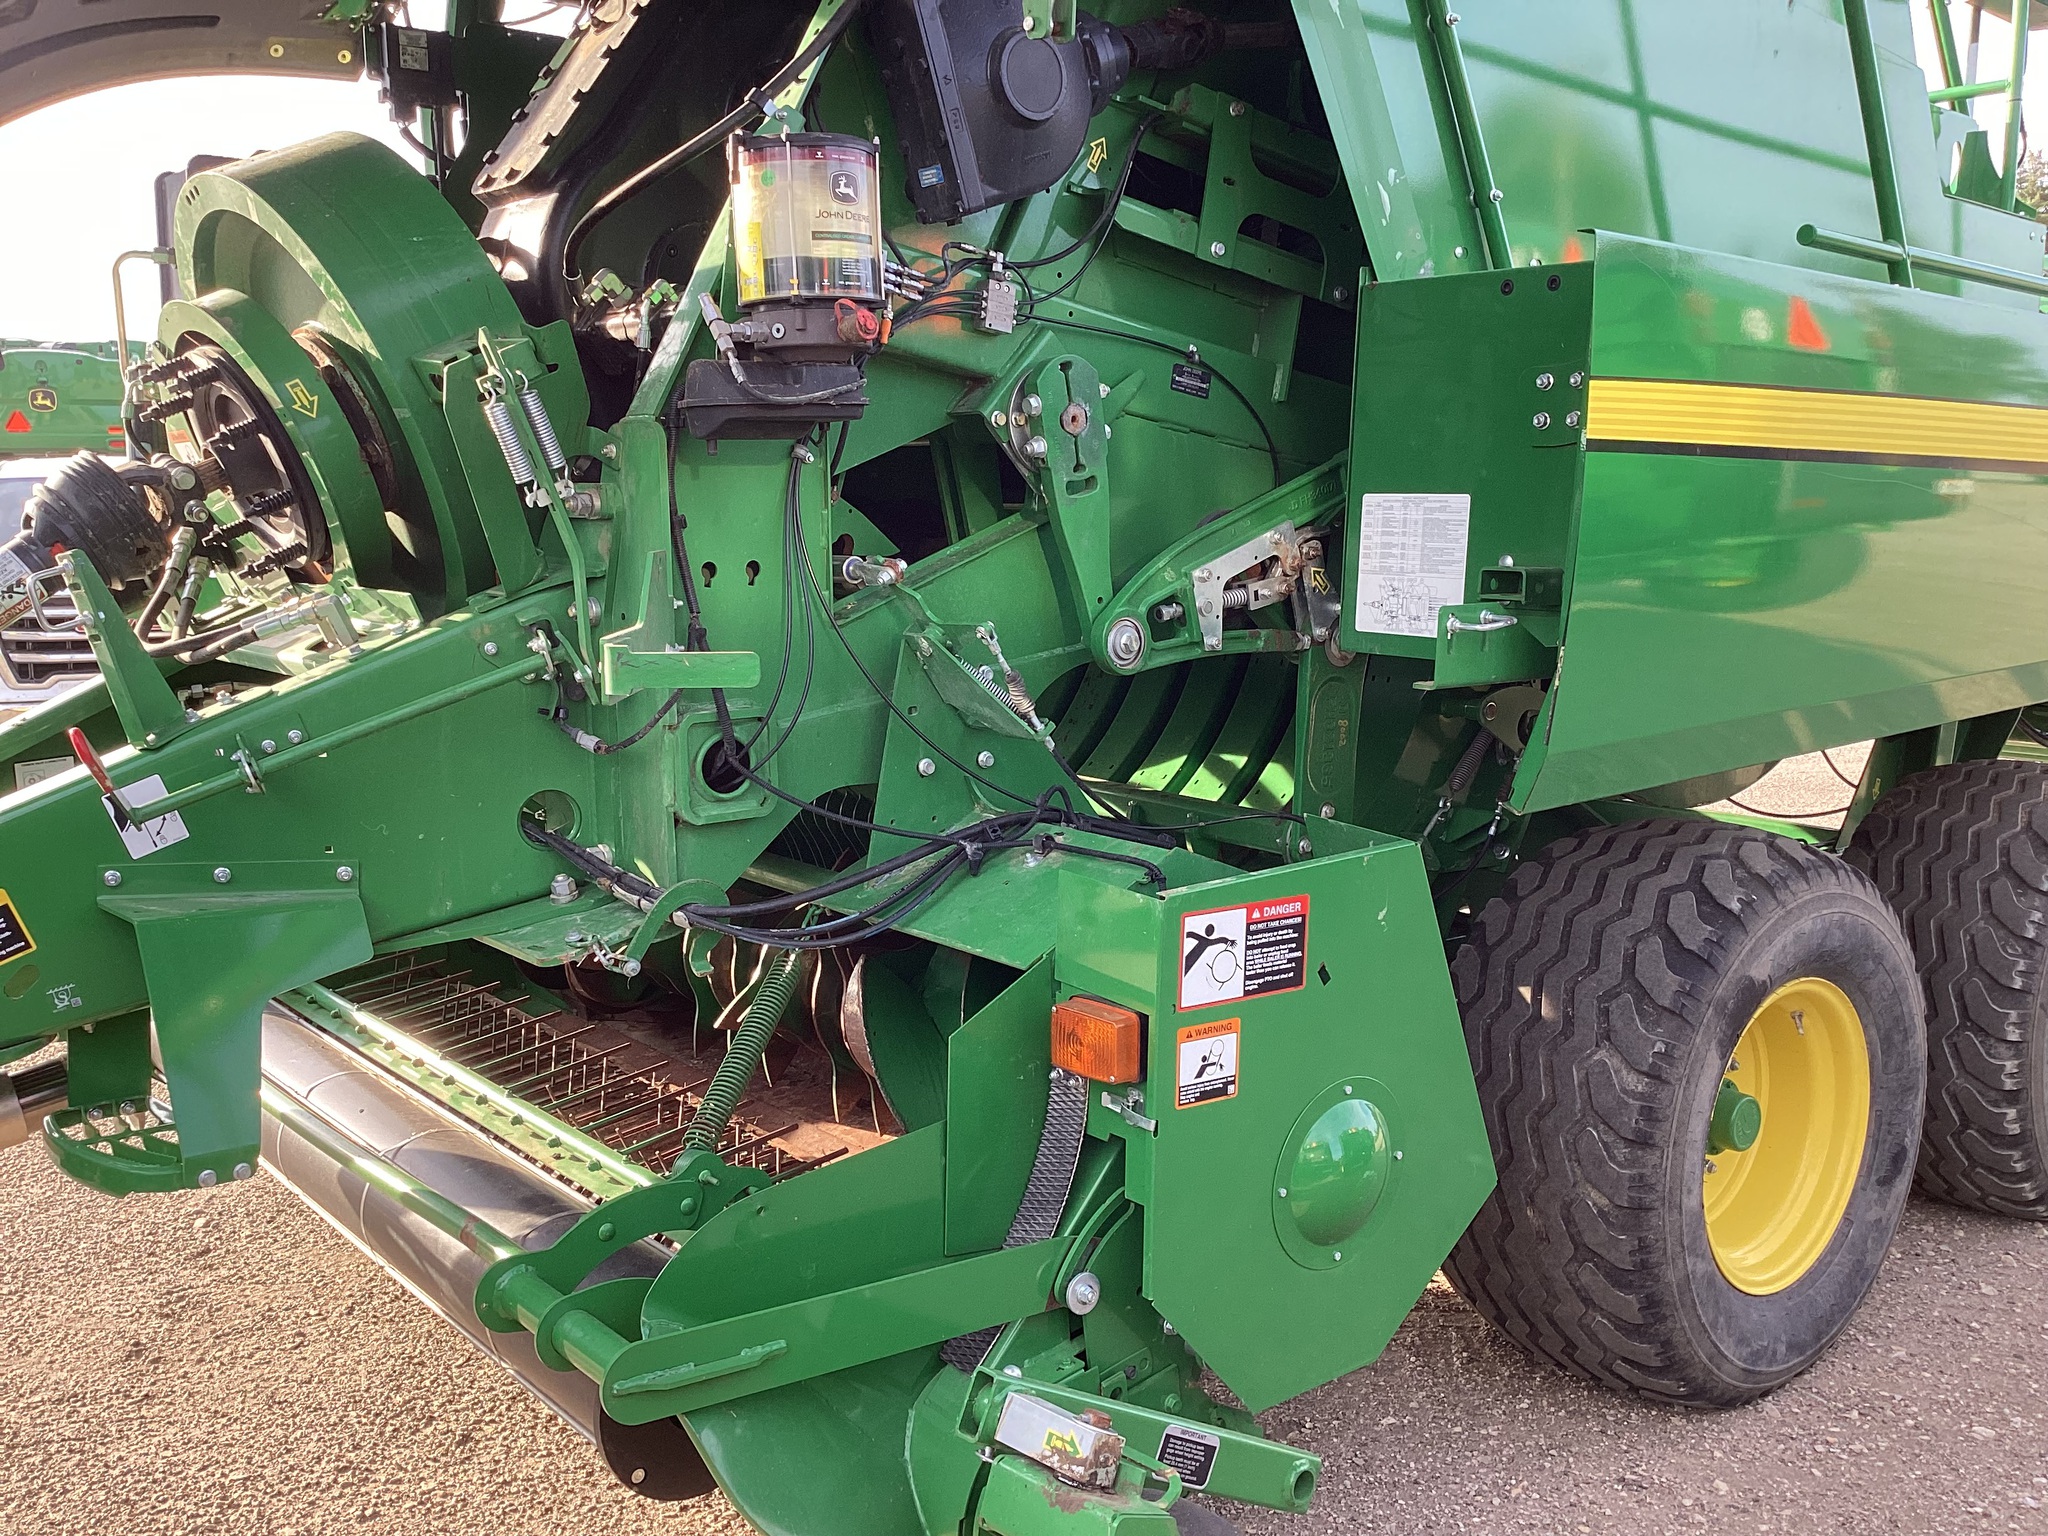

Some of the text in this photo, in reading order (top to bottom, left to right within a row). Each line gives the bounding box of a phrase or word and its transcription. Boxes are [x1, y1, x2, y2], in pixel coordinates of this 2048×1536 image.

[815, 209, 870, 223] JOHN DEERE
[1264, 902, 1301, 917] DANGER
[1195, 1022, 1232, 1037] WARNING
[1180, 1429, 1207, 1440] IMPORTANT
